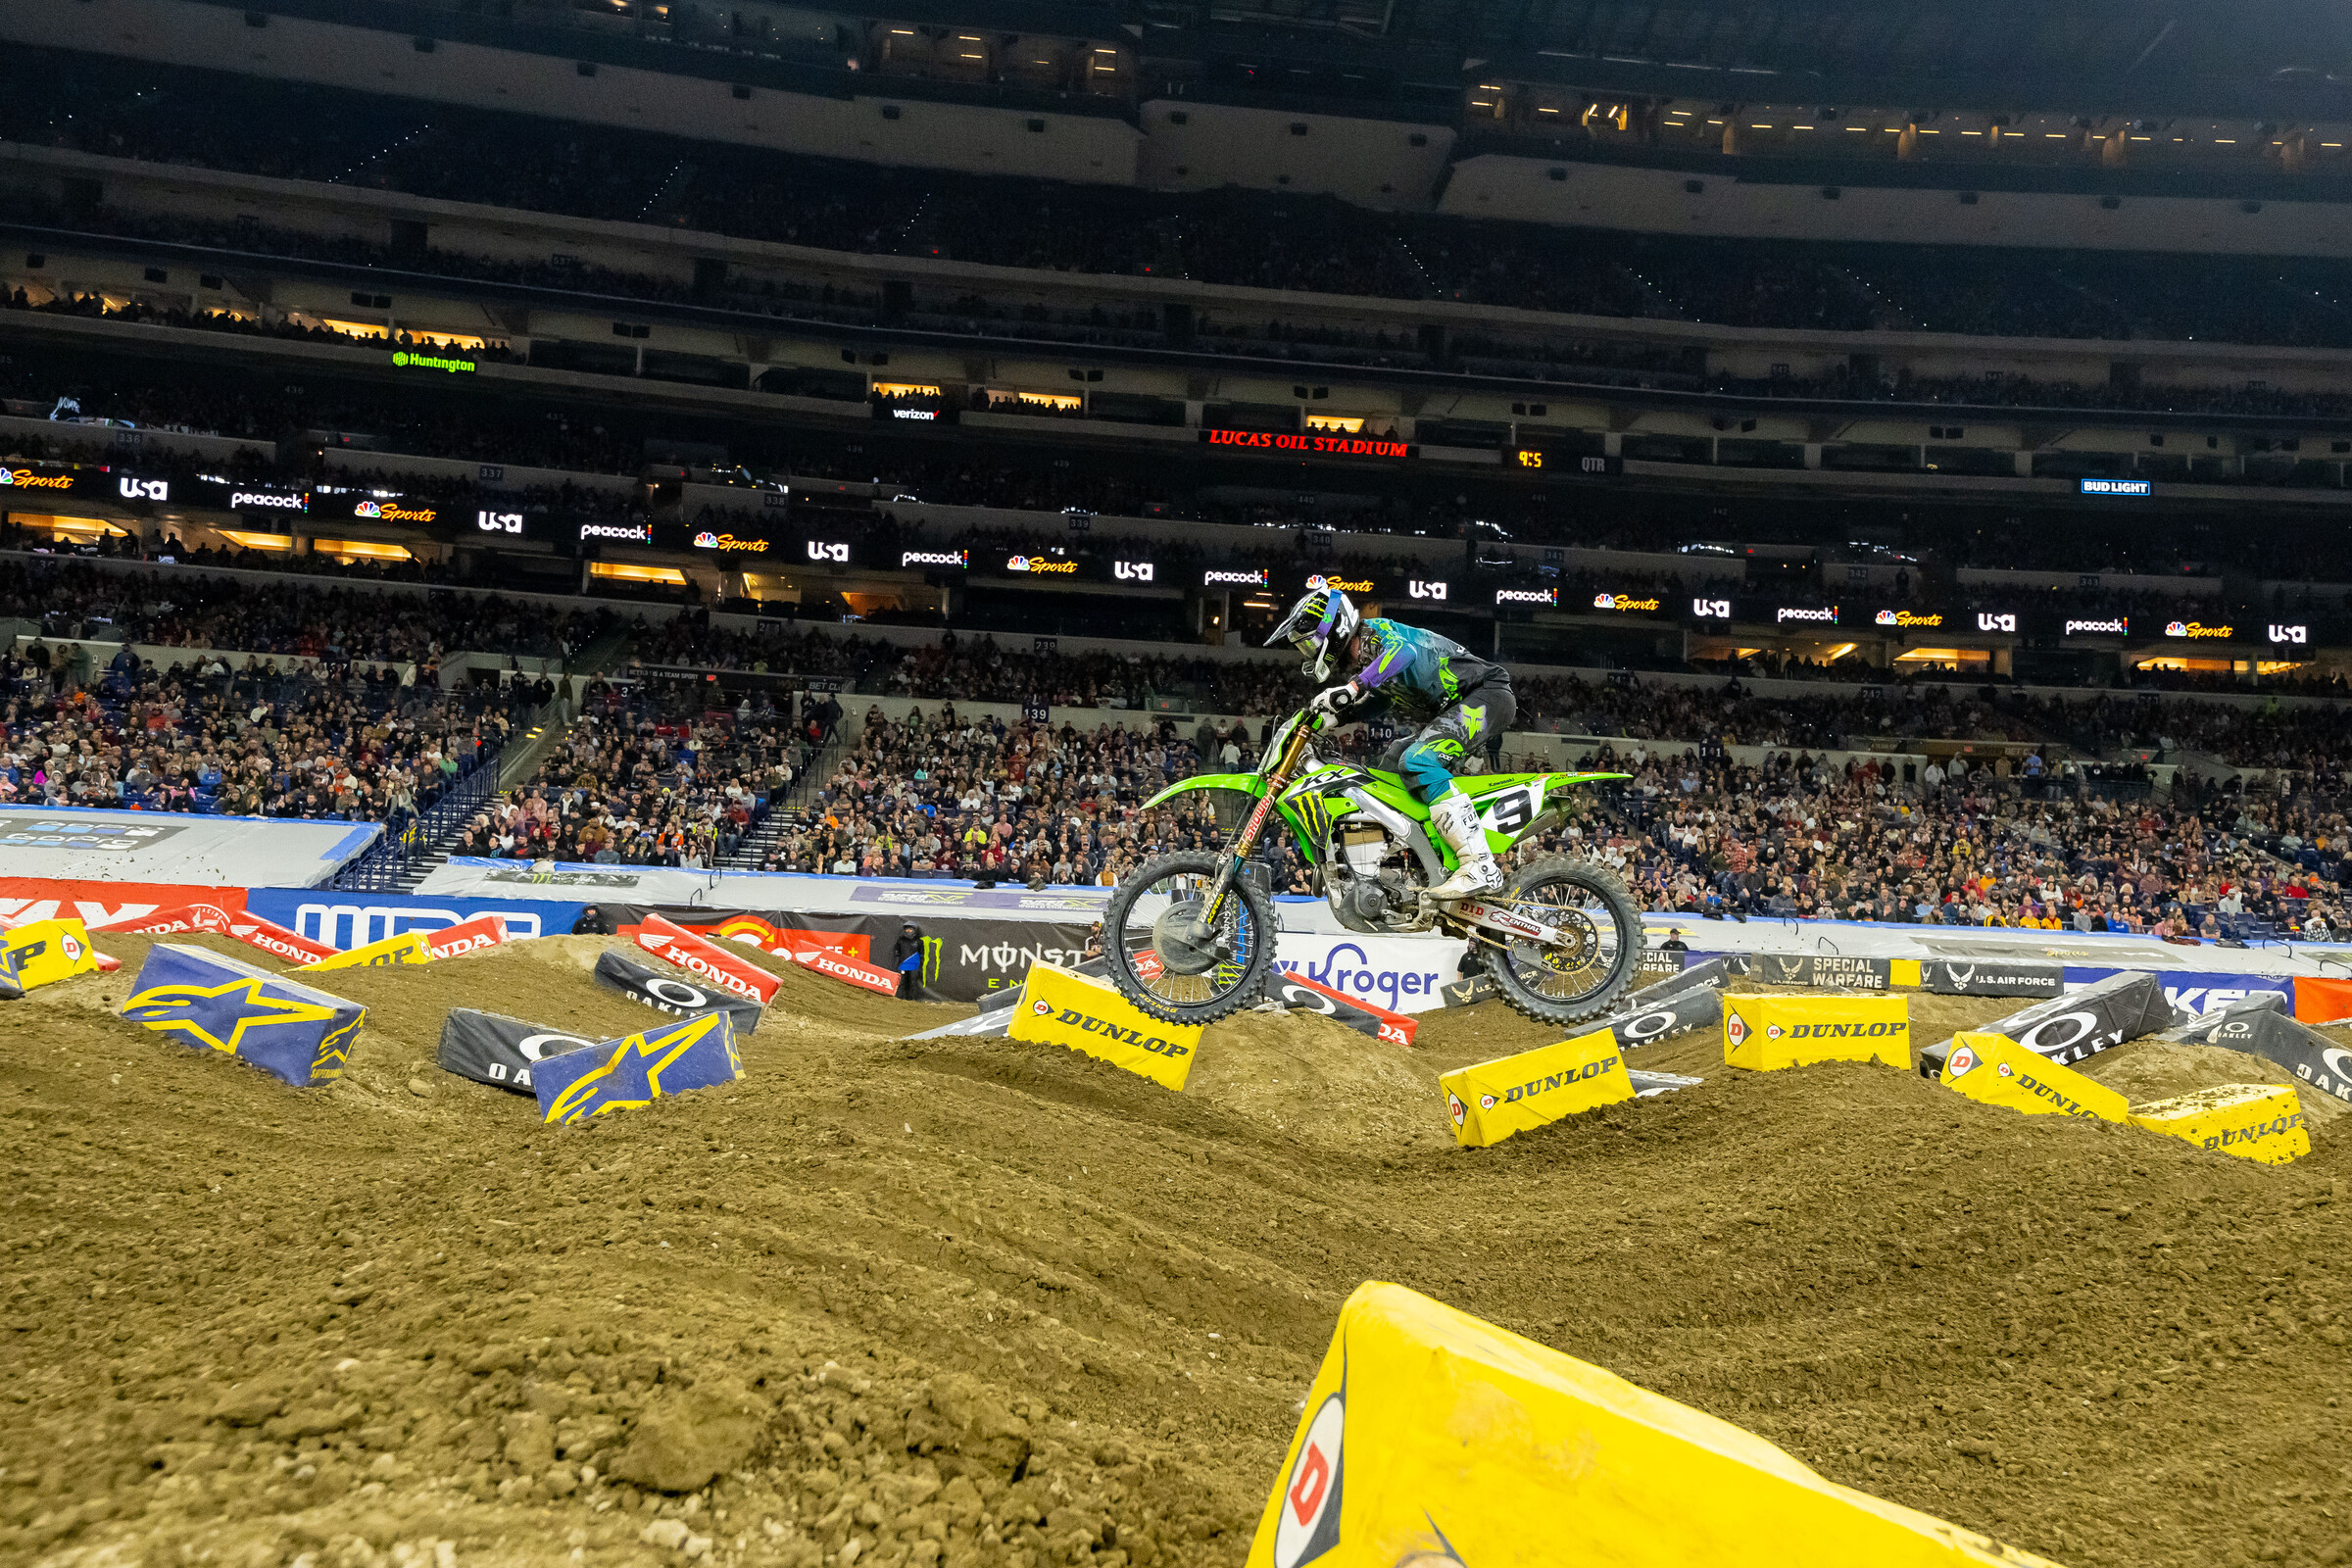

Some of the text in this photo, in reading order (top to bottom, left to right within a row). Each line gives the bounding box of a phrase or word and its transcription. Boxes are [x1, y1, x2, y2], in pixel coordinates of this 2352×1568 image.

[409, 352, 475, 373] Huntington
[893, 408, 935, 420] verizon
[119, 432, 141, 444] 336
[1209, 429, 1408, 458] LUCAS OIL STADIUM
[481, 467, 503, 479] 337
[1581, 457, 1605, 472] QTR
[12, 467, 74, 489] Sports
[2083, 481, 2147, 493] BUD LIGHT
[230, 492, 303, 509] peacock
[766, 496, 786, 507] 338
[379, 502, 437, 522] Sports
[580, 523, 646, 540] peacock
[1070, 517, 1090, 528] 339
[716, 533, 769, 553] Sports
[902, 550, 963, 567] peacock
[1029, 556, 1078, 575] Sports
[1204, 569, 1263, 586] peacock
[1849, 568, 1868, 579] 342
[1326, 575, 1375, 593] Sports
[1495, 588, 1553, 605] peacock
[1614, 594, 1660, 612] Sports
[1777, 607, 1834, 623] peacock
[1895, 610, 1943, 628] Sports
[2065, 618, 2124, 636] peacock
[2186, 621, 2233, 640] Sports
[808, 681, 827, 691] BET
[1024, 709, 1048, 720] 139
[1701, 747, 1722, 759] 11
[1299, 766, 1348, 790] KX
[1488, 777, 1515, 788] Kawasaki
[1245, 797, 1271, 841] SHOWA
[1494, 790, 1533, 834] 9
[1460, 902, 1485, 916] DID
[253, 933, 327, 964] HOND
[665, 945, 761, 1002] HONDA
[816, 957, 894, 990] HONDA
[1813, 957, 1874, 973] SPECIAL
[1308, 943, 1439, 1011] Kroger
[1813, 973, 1883, 989] WARFARE
[1976, 975, 1996, 984] U.S.
[1054, 1008, 1189, 1058] DUNLOP
[1789, 1022, 1907, 1039] DUNLOP
[2051, 1029, 2124, 1066] KLEY
[1503, 1056, 1619, 1103] DUNLOP
[2016, 1073, 2100, 1119] DUNLO
[2203, 1111, 2303, 1152] DUNLOP
[1290, 1443, 1329, 1525] D
